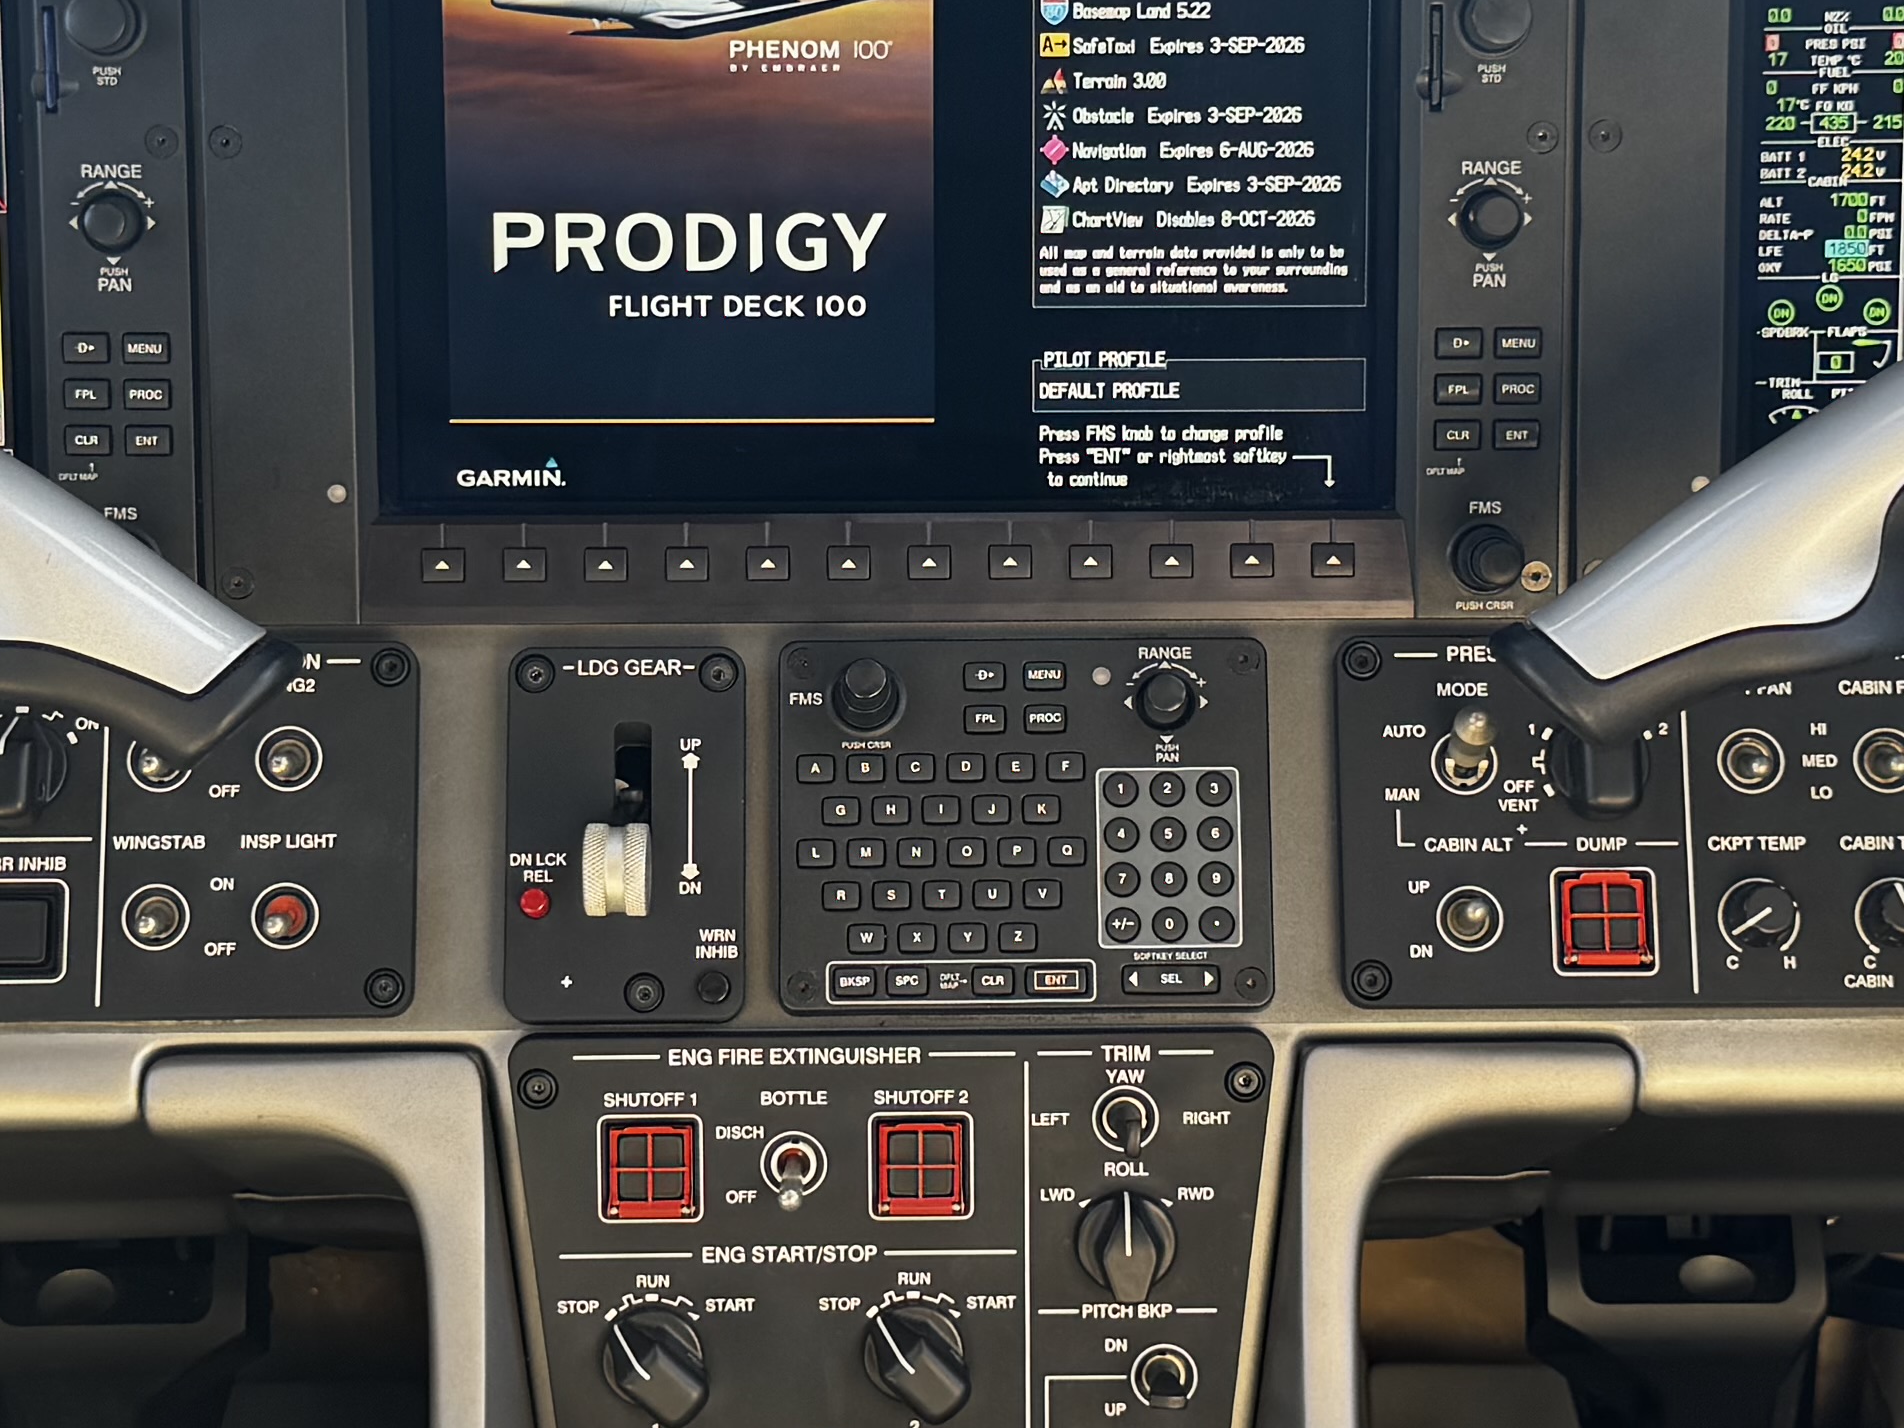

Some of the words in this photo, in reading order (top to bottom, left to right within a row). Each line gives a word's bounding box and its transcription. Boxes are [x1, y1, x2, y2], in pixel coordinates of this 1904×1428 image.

[1072, 1, 1131, 21] Basemap
[1136, 1, 1172, 20] Land
[1176, 1, 1212, 19] 5.22
[729, 39, 840, 59] PHENOM
[1072, 36, 1136, 55] SafeTaxi
[1149, 36, 1205, 56] Expires
[1209, 35, 1306, 54] 3-SEP-2026
[1072, 71, 1127, 90] Terrain
[1132, 71, 1167, 90] 3.00
[1072, 106, 1135, 125] Obstacle
[1147, 106, 1202, 126] Expires
[1207, 105, 1303, 124] 3-SEP-2026
[1072, 210, 1144, 229] ChartView
[1156, 210, 1216, 228] Disables
[1220, 209, 1316, 228] 8-OCT-2026
[492, 211, 887, 273] PRODIGY
[609, 294, 713, 318] FLIGHT
[723, 294, 805, 318] DECK
[816, 294, 867, 317] 100
[1042, 350, 1093, 370] PILOT
[1098, 350, 1168, 369] PROFILE
[1039, 381, 1106, 400] DEFAULT
[1112, 381, 1181, 399] PROFILE
[1038, 424, 1081, 442] Press
[1085, 424, 1117, 442] FMS
[1121, 424, 1154, 442] knob
[1159, 425, 1177, 442] to
[1181, 424, 1229, 444] change
[1234, 423, 1284, 443] profile
[1138, 646, 1192, 660] RANGE
[577, 658, 619, 676] LDG
[623, 658, 682, 676] GEAR
[1027, 669, 1062, 680] MENU
[1838, 679, 1893, 696] CABIN
[112, 834, 206, 851] WINGSTAB
[240, 833, 282, 850] INSP
[285, 833, 338, 849] LIGHT
[1576, 836, 1628, 852] DUMP
[1707, 835, 1752, 852] CKPT
[1756, 835, 1807, 852] TEMP
[18, 855, 67, 872] INHIB
[668, 1048, 713, 1067] ENG
[718, 1048, 764, 1066] FIRE
[769, 1046, 921, 1066] EXTINGUISHER
[1100, 1044, 1151, 1063] TRIM
[760, 1090, 828, 1106] BOTTLE
[873, 1089, 955, 1106] SHUTOFF
[959, 1089, 969, 1104] 2
[1182, 1110, 1231, 1125] RIGHT
[701, 1245, 746, 1264] ENG
[751, 1244, 878, 1265] START/STOP
[1081, 1303, 1134, 1319] PITCH
[1137, 1303, 1173, 1319] BKP
